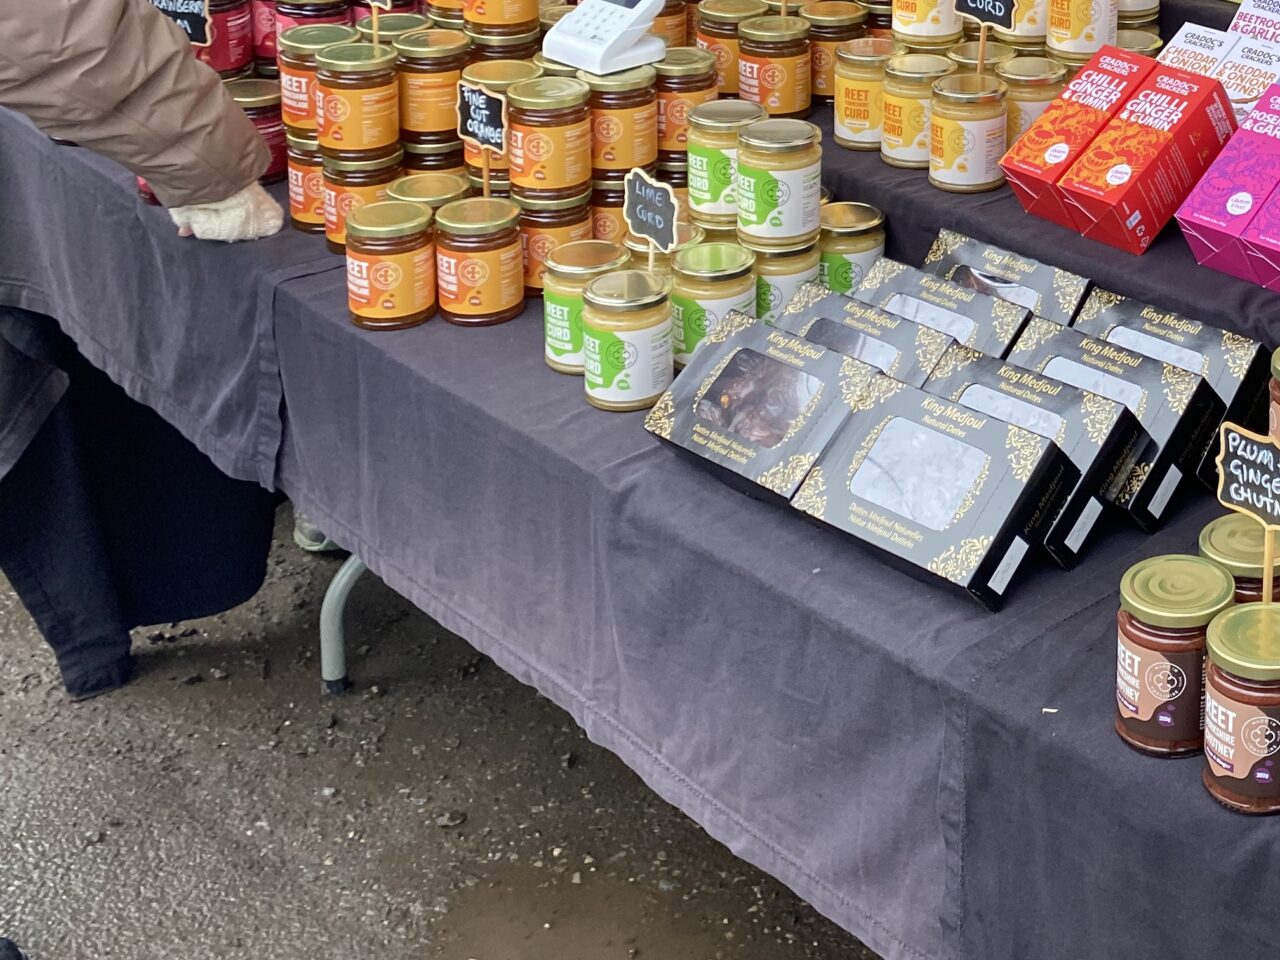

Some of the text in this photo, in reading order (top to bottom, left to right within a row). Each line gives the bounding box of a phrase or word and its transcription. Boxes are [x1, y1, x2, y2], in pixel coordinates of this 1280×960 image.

[1222, 60, 1277, 82] CHEDDAR
[1226, 71, 1269, 91] ONION
[845, 87, 869, 101] REET
[1156, 75, 1199, 93] CRADOC'S
[1156, 81, 1190, 96] CRACKERS
[462, 86, 487, 108] FINE
[1138, 90, 1189, 112] CHILLI
[470, 105, 490, 123] CUT
[844, 106, 869, 120] CURD
[1126, 99, 1183, 125] GINGER
[1130, 112, 1172, 132] CUMIN
[466, 119, 502, 143] ORANGE
[635, 181, 664, 207] LIME
[636, 205, 664, 229] CURD
[920, 396, 987, 431] King Medjoul
[921, 414, 966, 439] Natural Dates
[1227, 432, 1274, 472] PLUM
